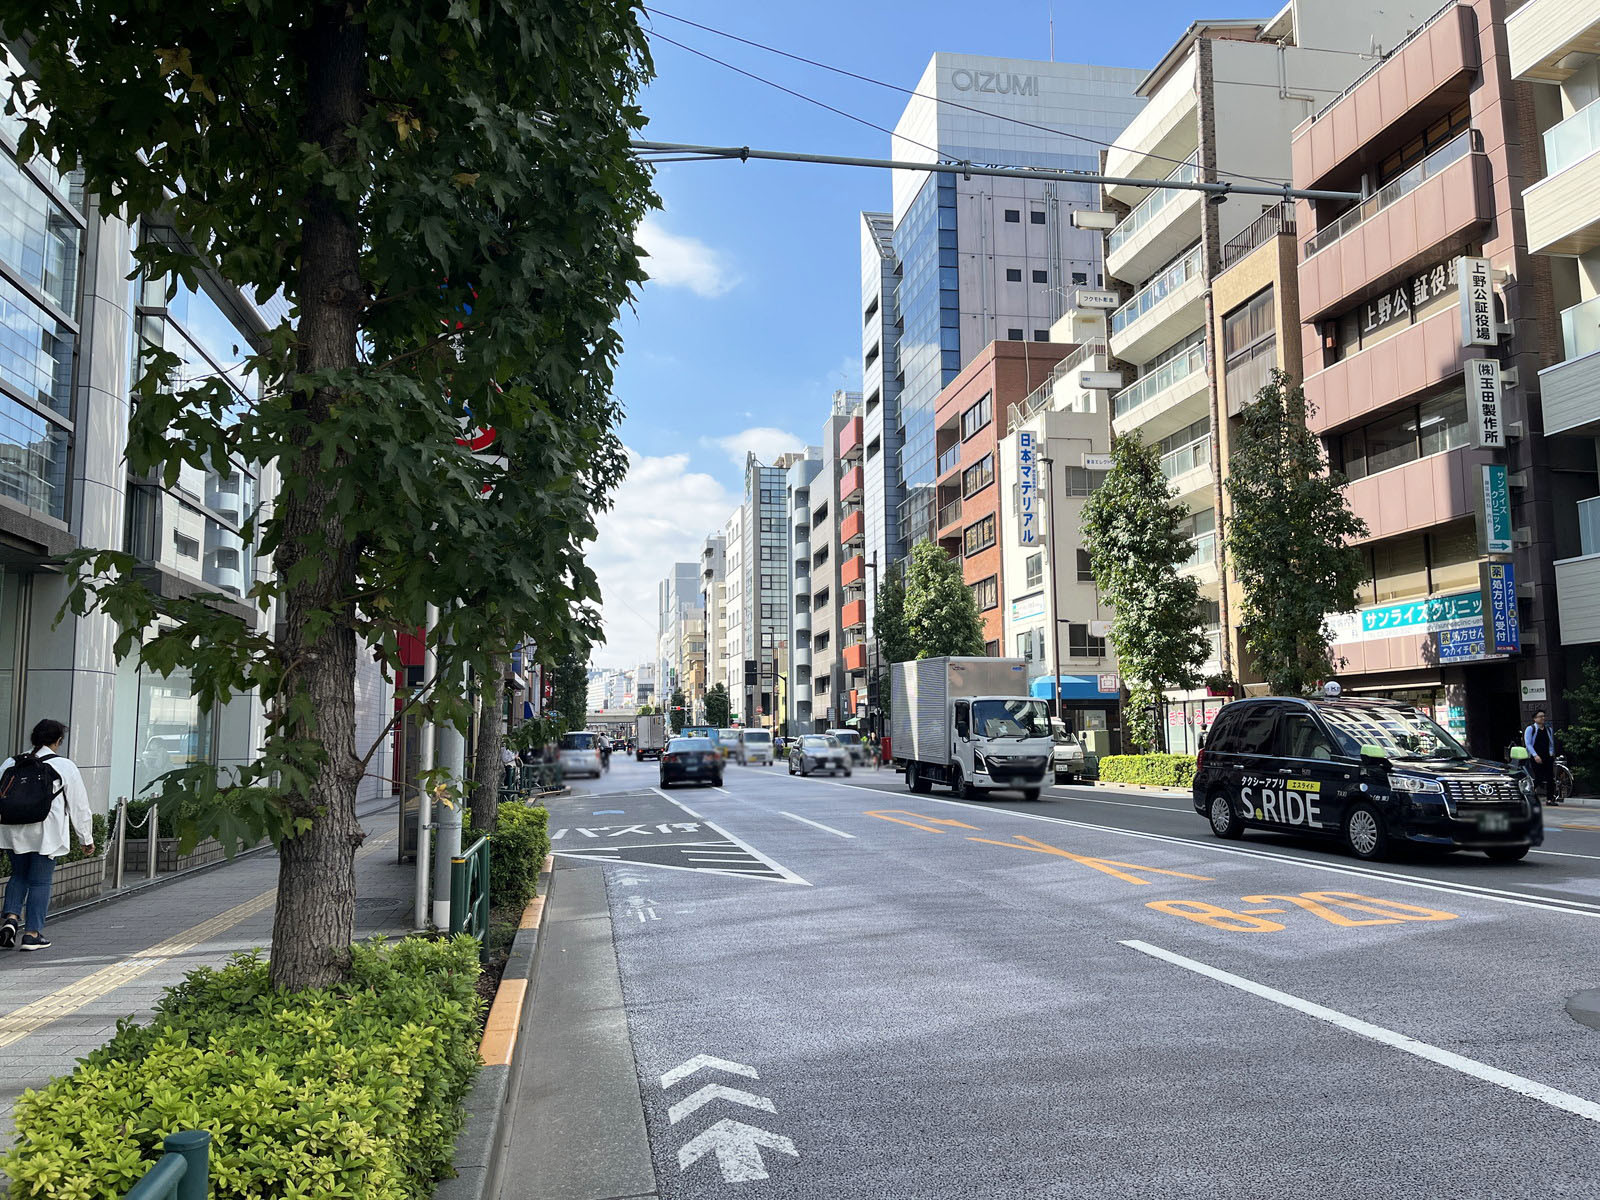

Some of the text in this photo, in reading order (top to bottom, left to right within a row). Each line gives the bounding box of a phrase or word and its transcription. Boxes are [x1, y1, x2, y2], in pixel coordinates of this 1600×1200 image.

[952, 69, 1039, 96] OIZUMI
[1472, 261, 1491, 340] 上野公証役場
[1020, 433, 1034, 543] 日本マテリアル
[1497, 471, 1507, 514] サンライズ
[1491, 490, 1501, 533] クリニック
[1492, 579, 1506, 642] 処方せん受付
[1241, 776, 1315, 790] タクシーアプリ エスライド
[1241, 787, 1323, 829] S.RIDE
[551, 822, 701, 840] バス停
[1144, 891, 1460, 933] 8-20
